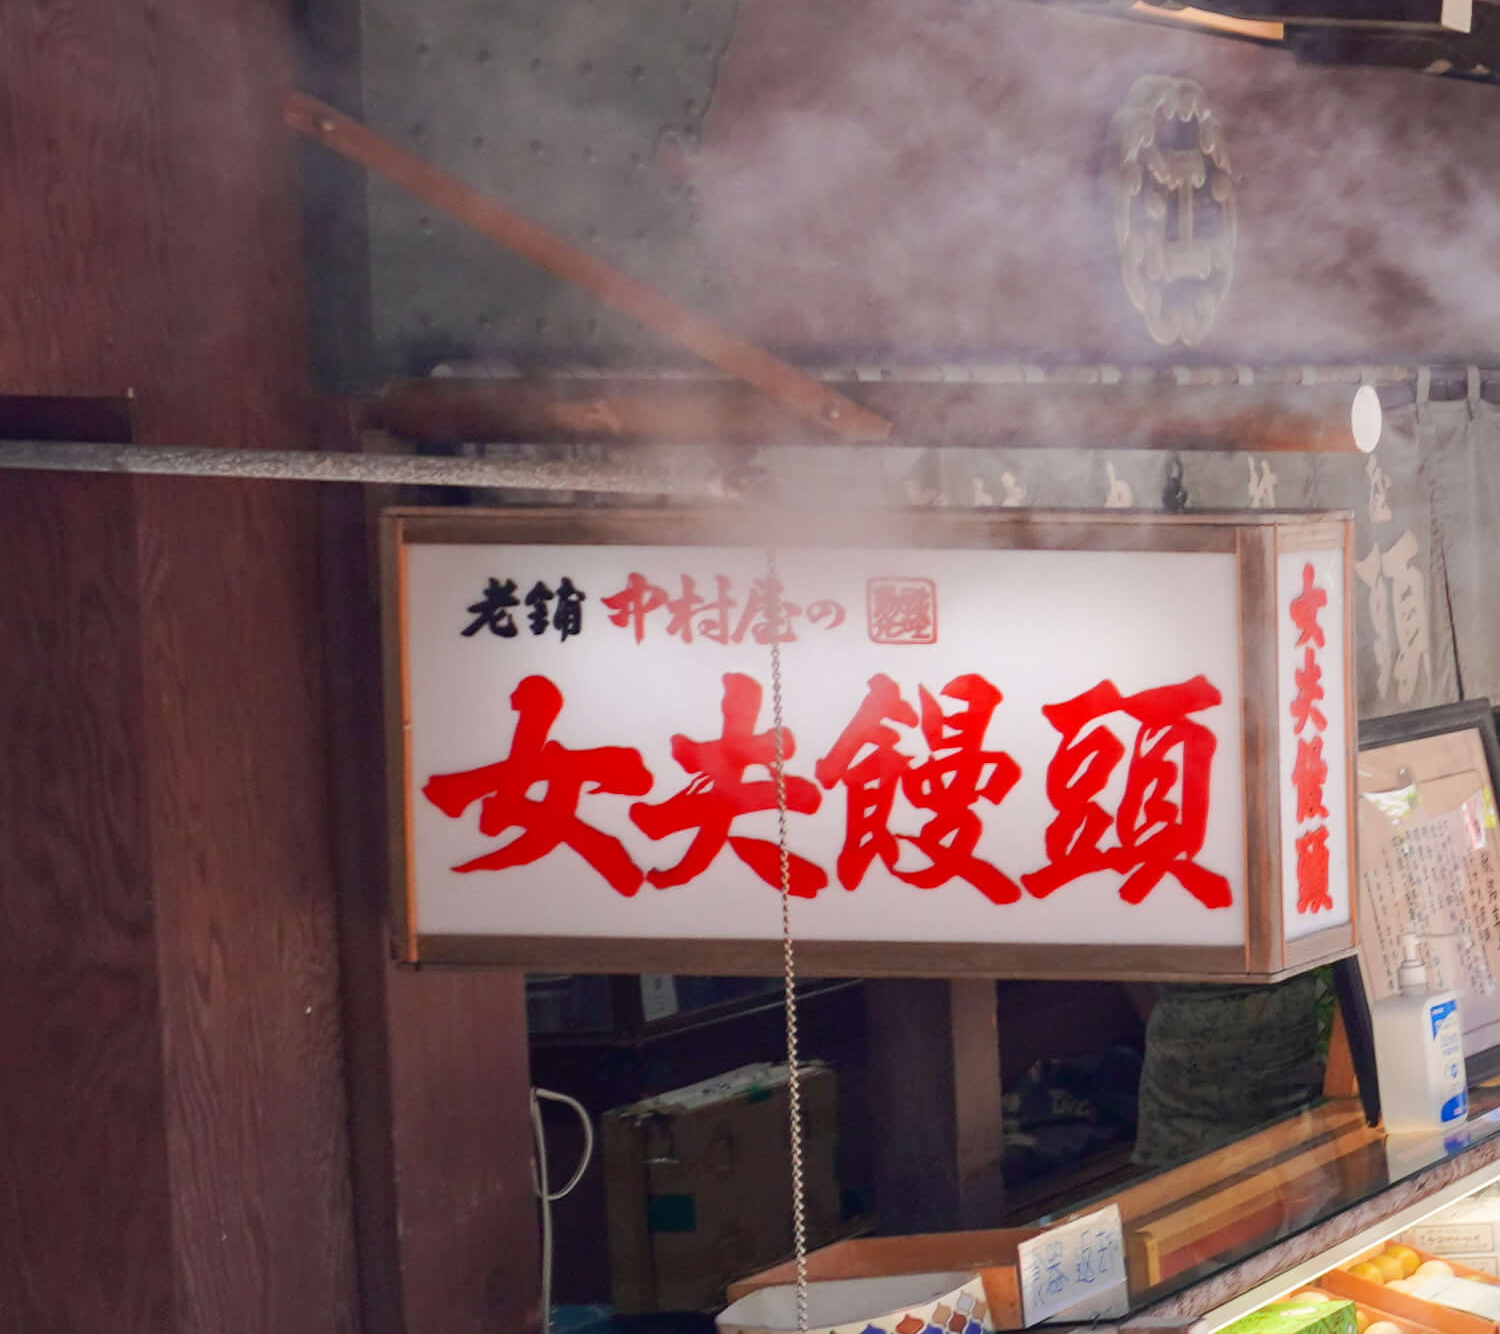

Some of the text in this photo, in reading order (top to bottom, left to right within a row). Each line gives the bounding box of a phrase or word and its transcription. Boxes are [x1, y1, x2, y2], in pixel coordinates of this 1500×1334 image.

[601, 572, 845, 645] 中村屋の
[422, 674, 1233, 911] 女夫饅頭
